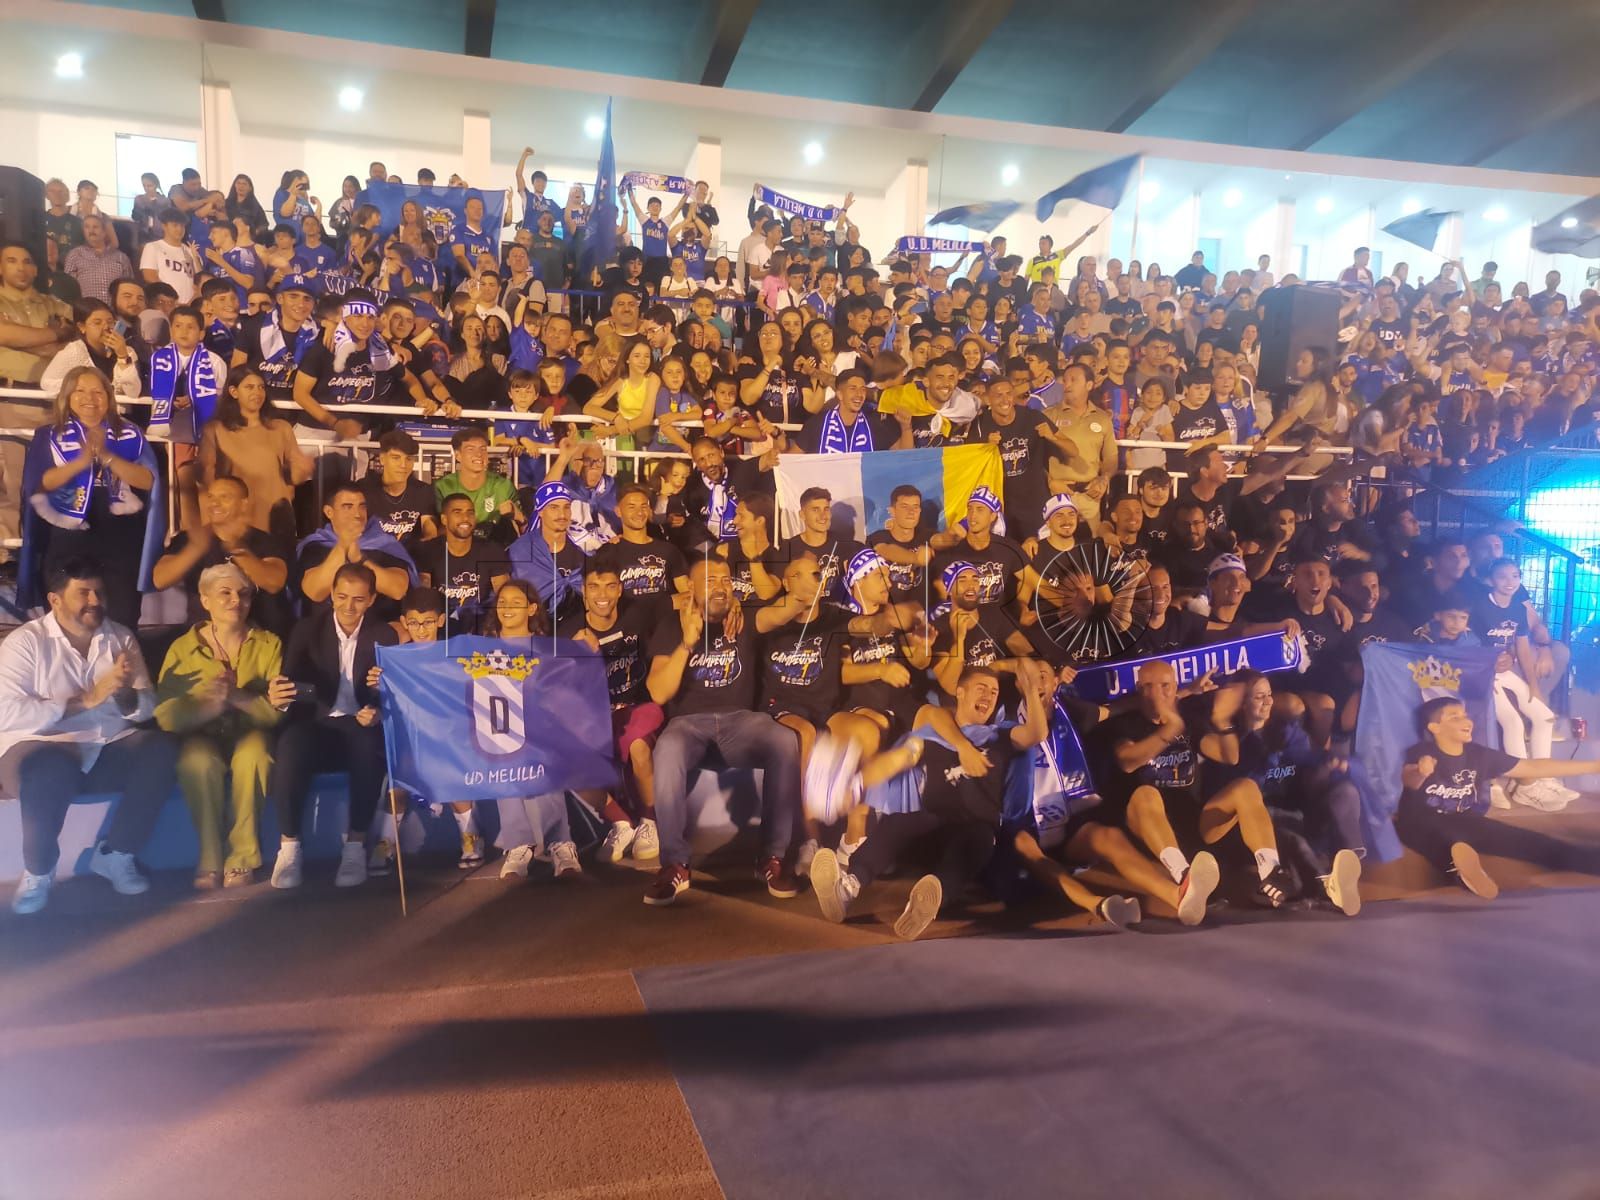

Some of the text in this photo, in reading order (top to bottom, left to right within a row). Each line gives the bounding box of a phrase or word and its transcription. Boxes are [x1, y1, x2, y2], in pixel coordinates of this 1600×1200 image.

[774, 193, 805, 214] MELILLA
[932, 241, 972, 251] MELILLA
[620, 567, 664, 581] CAMPEONES
[464, 763, 545, 786] UD MELILLA
[1265, 764, 1297, 780] EONES
